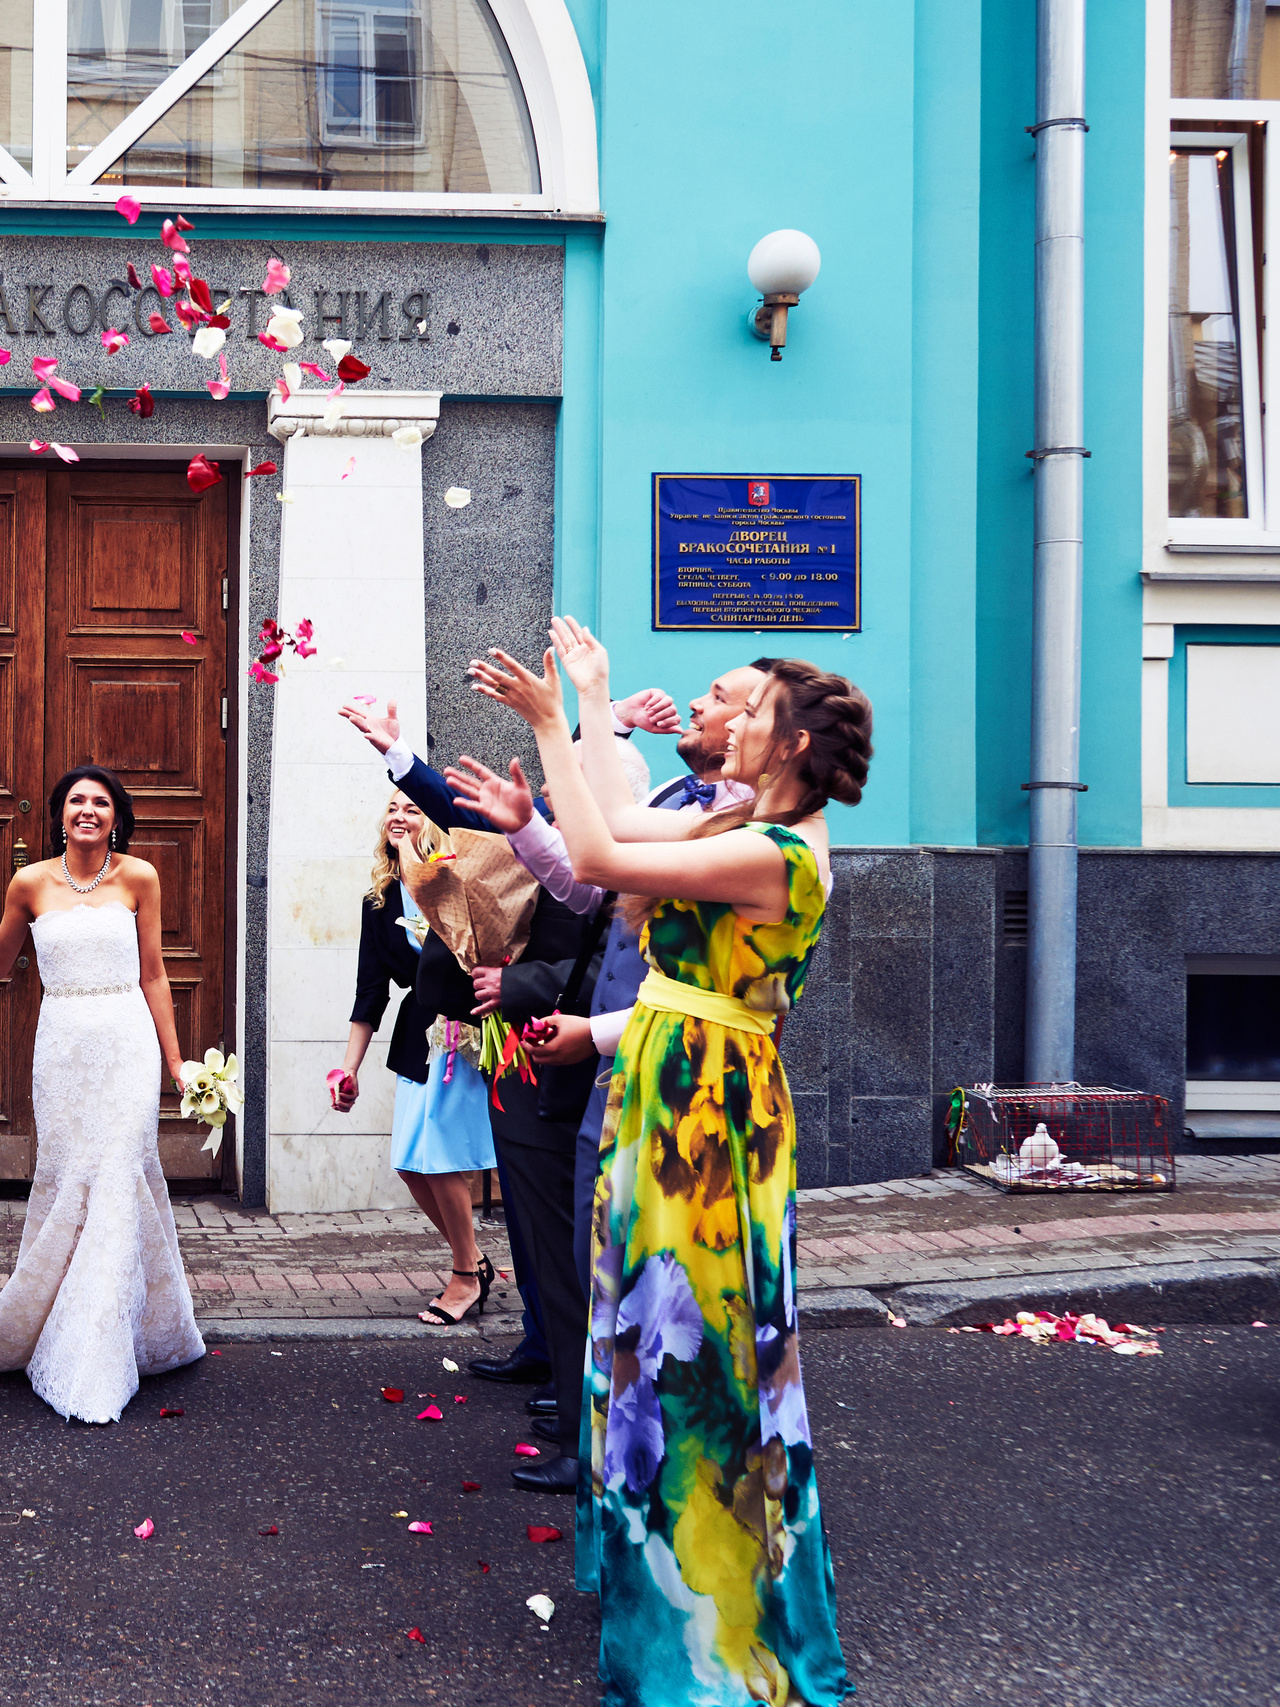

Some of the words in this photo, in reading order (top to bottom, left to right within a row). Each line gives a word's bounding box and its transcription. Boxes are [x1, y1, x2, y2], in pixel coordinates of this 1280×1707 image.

[728, 531, 788, 542] ДВОРЕЦ
[678, 543, 810, 553] БРАКОСОЧЕТАНИЯ
[830, 544, 836, 553] 1
[769, 573, 792, 581] 9.00
[810, 573, 839, 581] 18.00
[778, 615, 805, 623] ДЕНЬ
